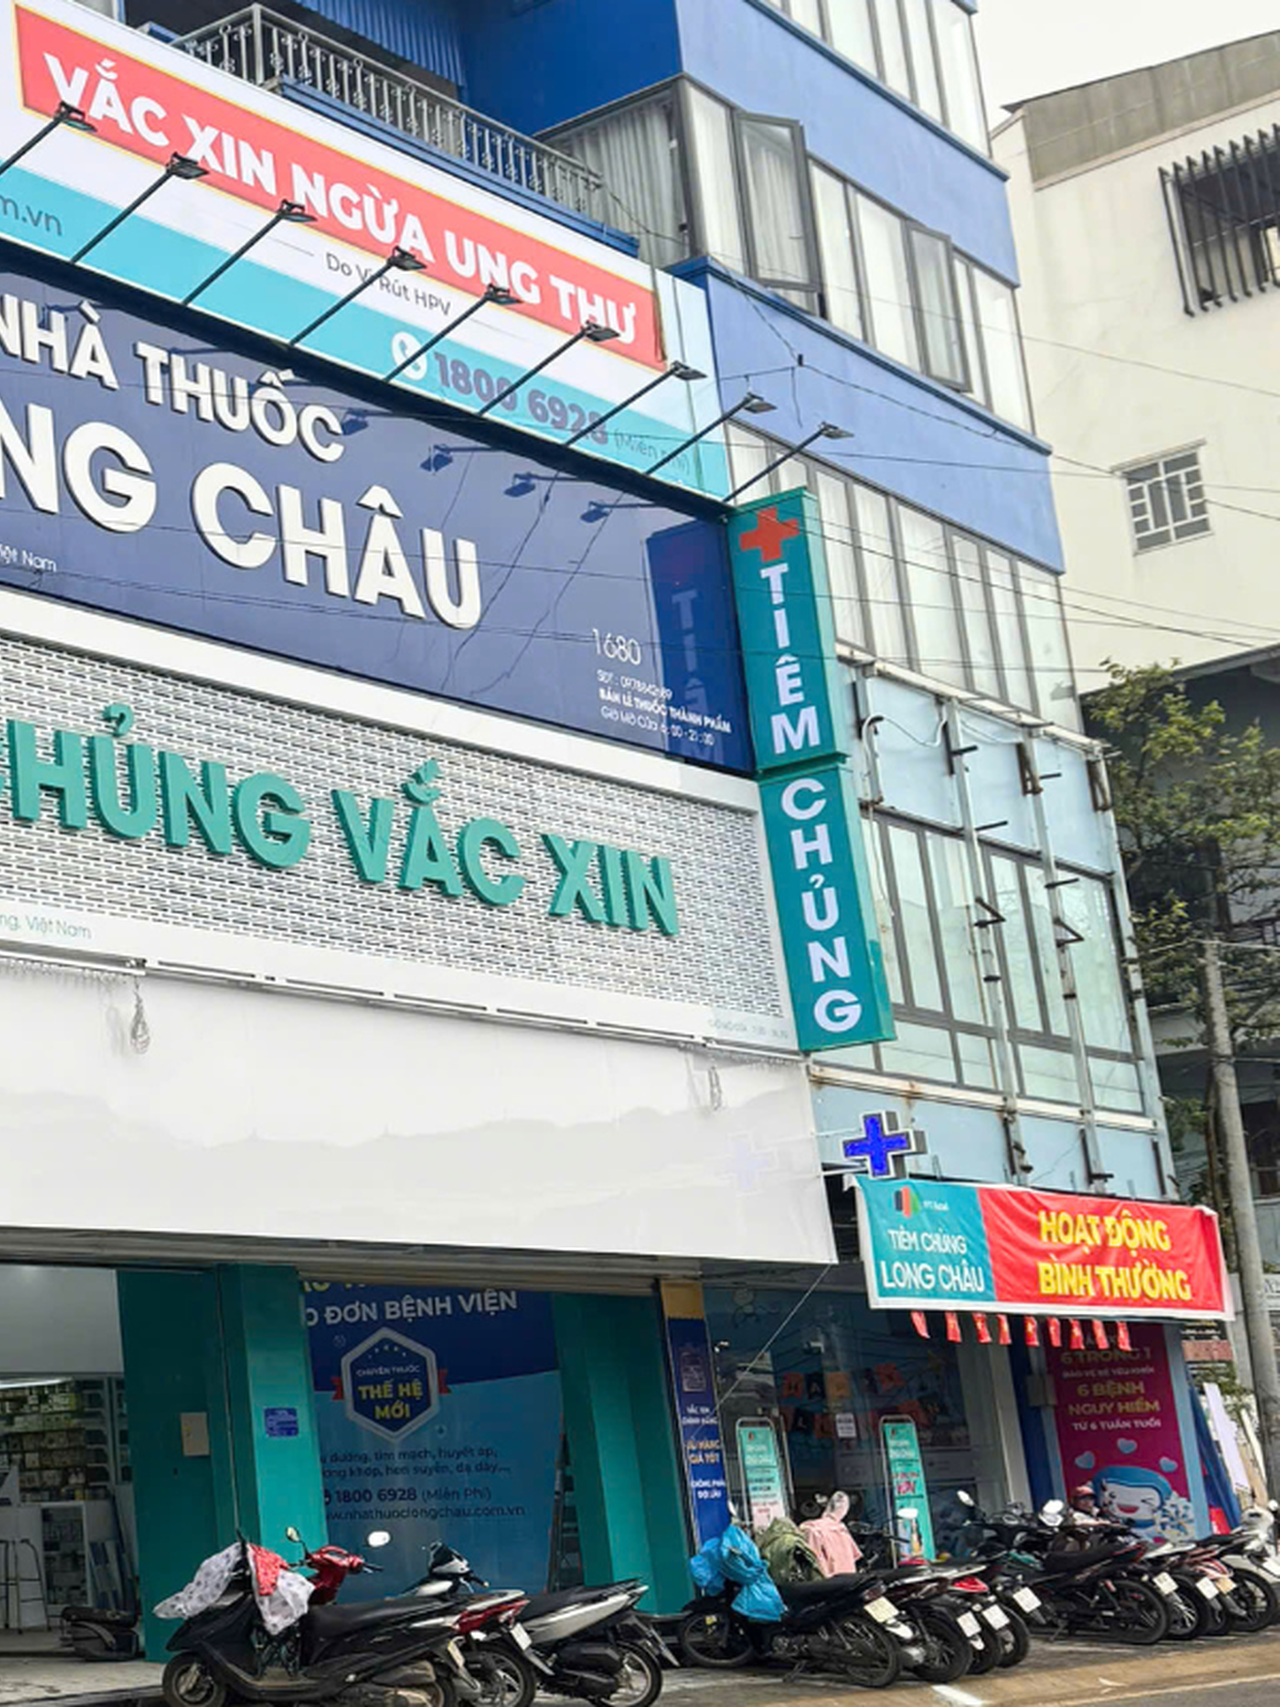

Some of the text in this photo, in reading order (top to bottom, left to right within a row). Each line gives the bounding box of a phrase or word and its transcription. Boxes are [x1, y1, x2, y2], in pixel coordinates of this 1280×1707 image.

[44, 51, 636, 344] VẮC XIN NGỪA UNG THƯ
[325, 252, 451, 316] Do Rút HPV
[133, 340, 347, 464] THUỐC
[22, 548, 57, 572] Nam
[189, 462, 482, 630] CHÂU
[592, 628, 641, 665] 1680
[760, 562, 863, 1033] TIÊM CHỦNG
[333, 757, 526, 908] VẮC
[541, 831, 680, 937] XIN
[56, 919, 92, 938] Nam
[887, 1225, 967, 1255] TIÊM CHỦNG
[1038, 1209, 1171, 1257] HOẠT ĐỘNG
[881, 1258, 985, 1292] LONG CHÂU
[1037, 1253, 1192, 1300] BÌNH THƯỜNG
[323, 1288, 518, 1325] ĐƠN BỆNH VIỆN
[358, 1377, 424, 1402] THẾ HỆ
[374, 1399, 411, 1420] MỚI
[335, 1489, 373, 1503] 1800
[377, 1487, 418, 1501] 6928
